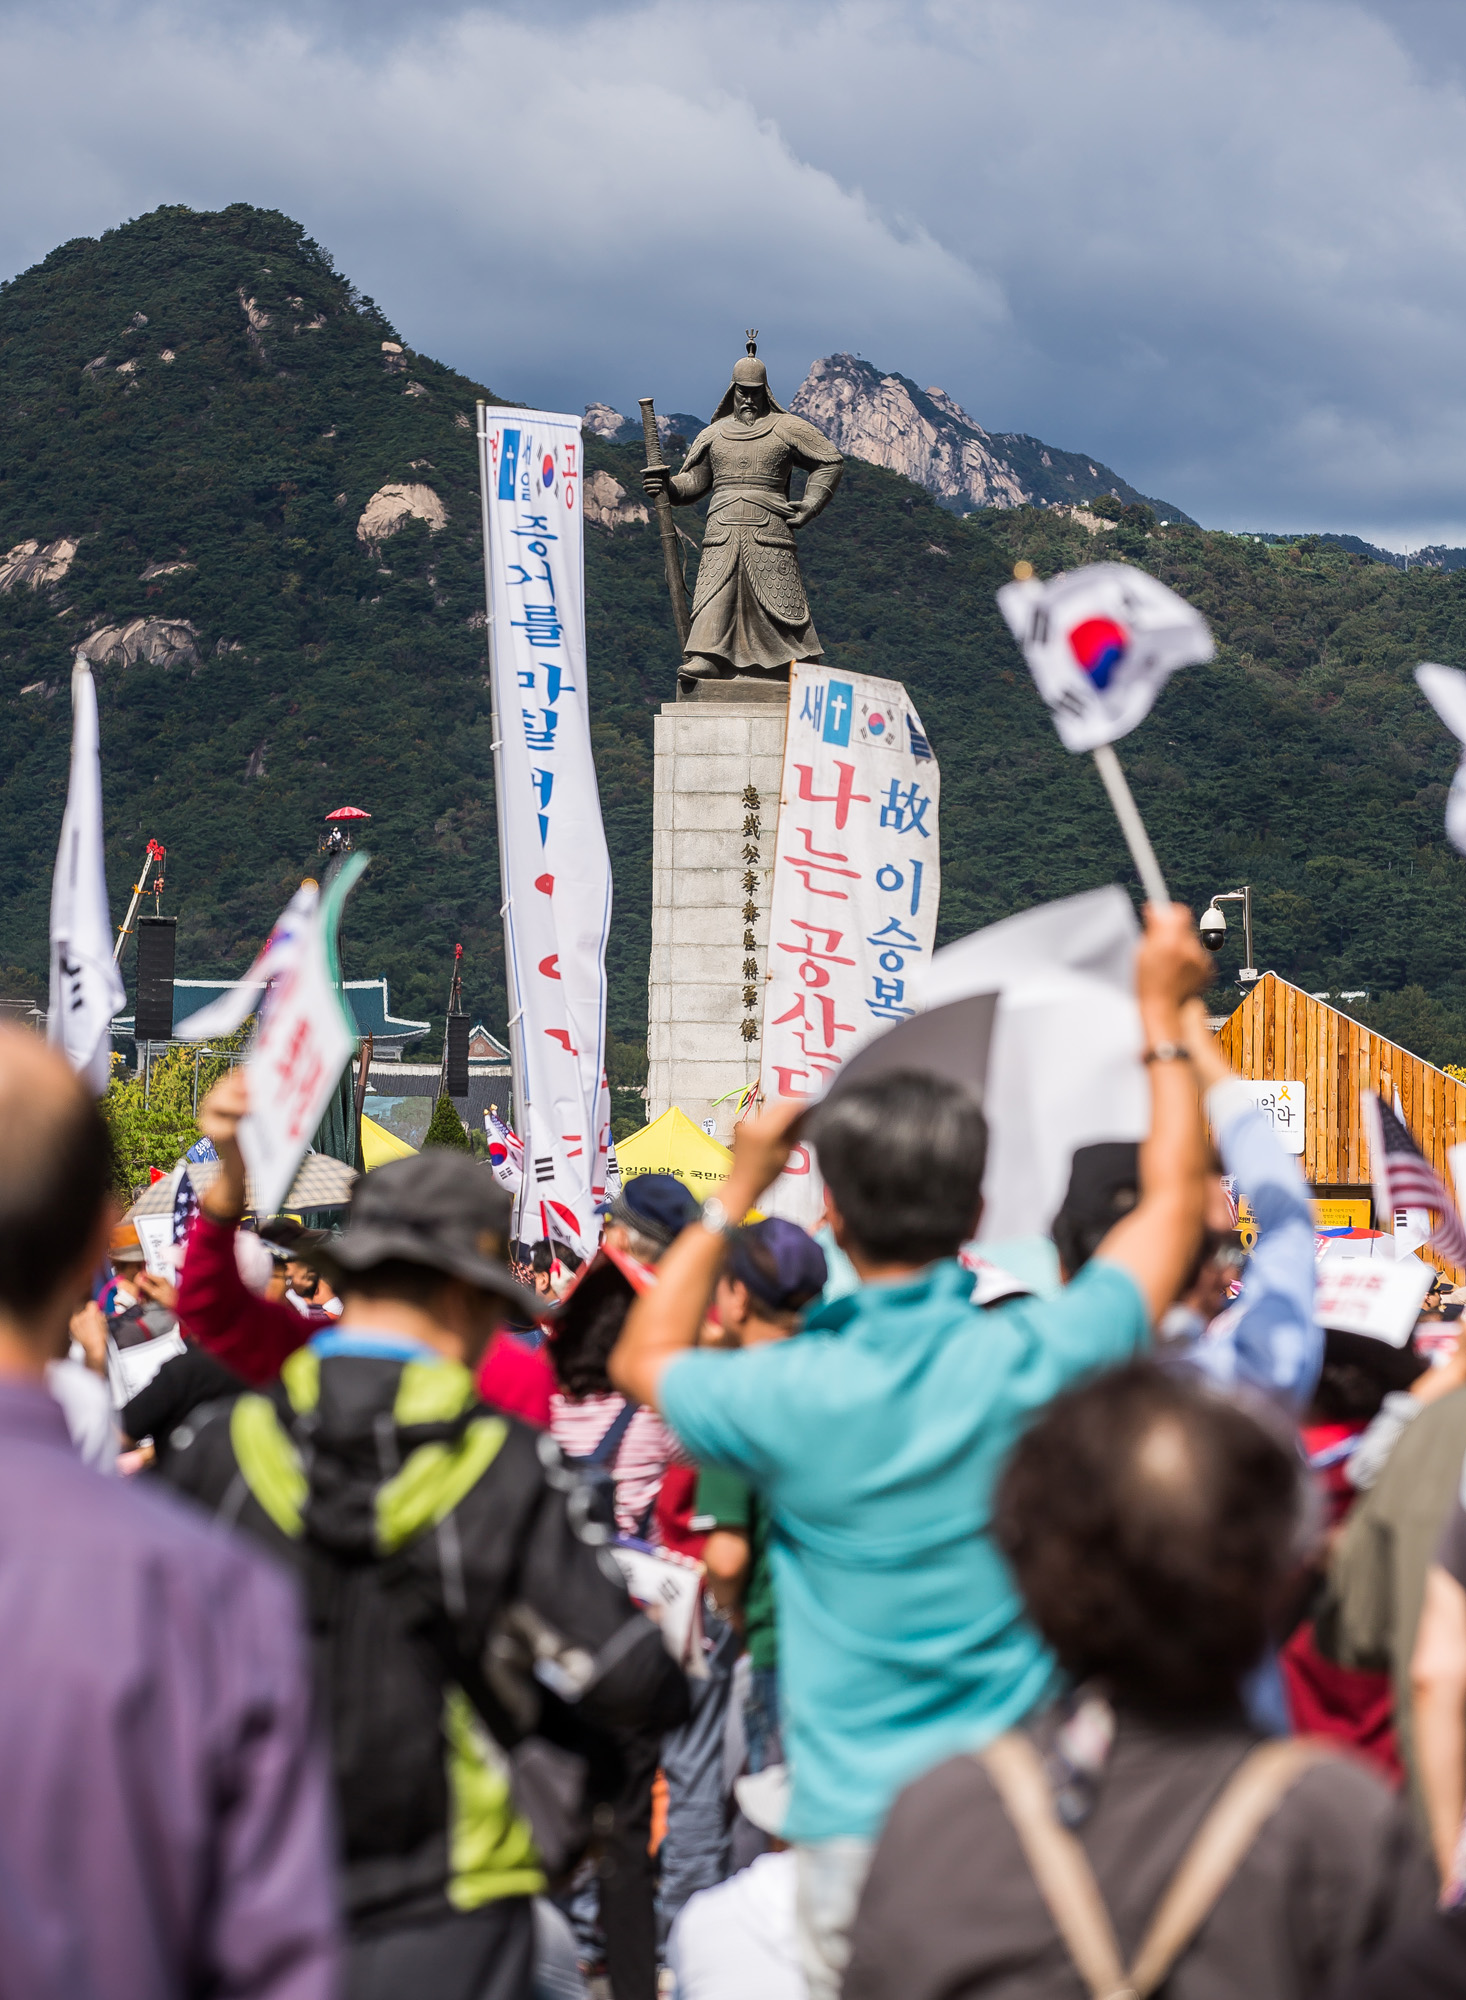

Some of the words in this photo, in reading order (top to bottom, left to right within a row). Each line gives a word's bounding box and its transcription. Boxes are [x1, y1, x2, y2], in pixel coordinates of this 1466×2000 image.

[799, 685, 825, 732] 새
[783, 759, 872, 900] 나는
[879, 777, 932, 839] 故
[771, 918, 857, 1210] 공산당
